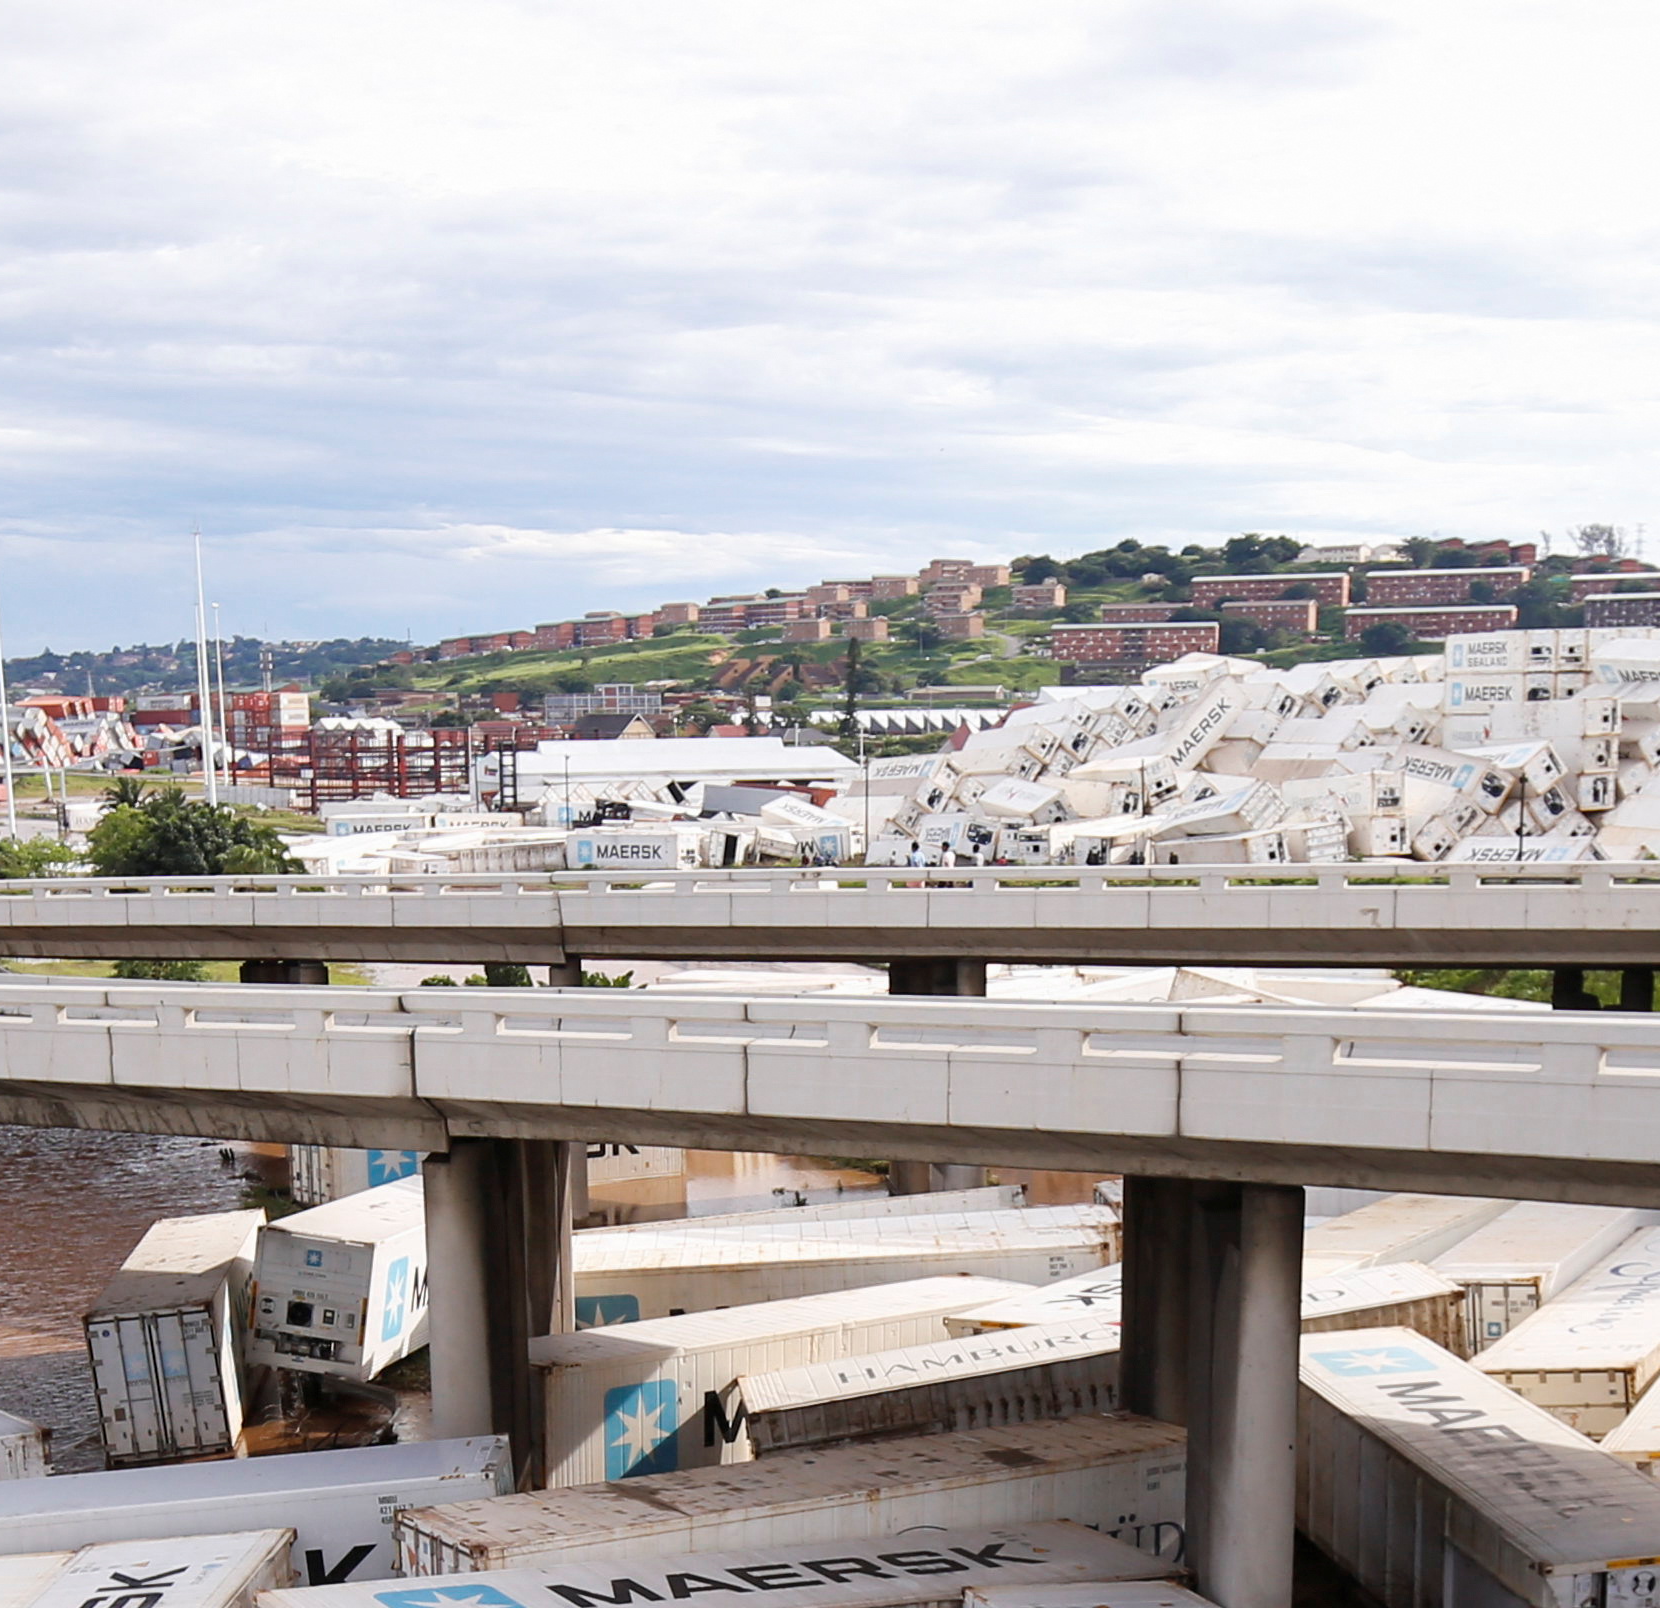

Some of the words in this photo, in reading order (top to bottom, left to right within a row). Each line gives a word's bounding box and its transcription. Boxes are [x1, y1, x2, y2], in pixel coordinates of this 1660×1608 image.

[1469, 641, 1508, 654] MAERSK
[1465, 686, 1513, 701] MAERSK
[1170, 697, 1232, 767] MAERSK
[1400, 756, 1457, 780] MAERSK
[596, 845, 662, 859] MAERSK
[839, 1322, 1122, 1385] HAMBURG
[1086, 1513, 1187, 1563] ÜD
[545, 1541, 1048, 1608] MAERSK
